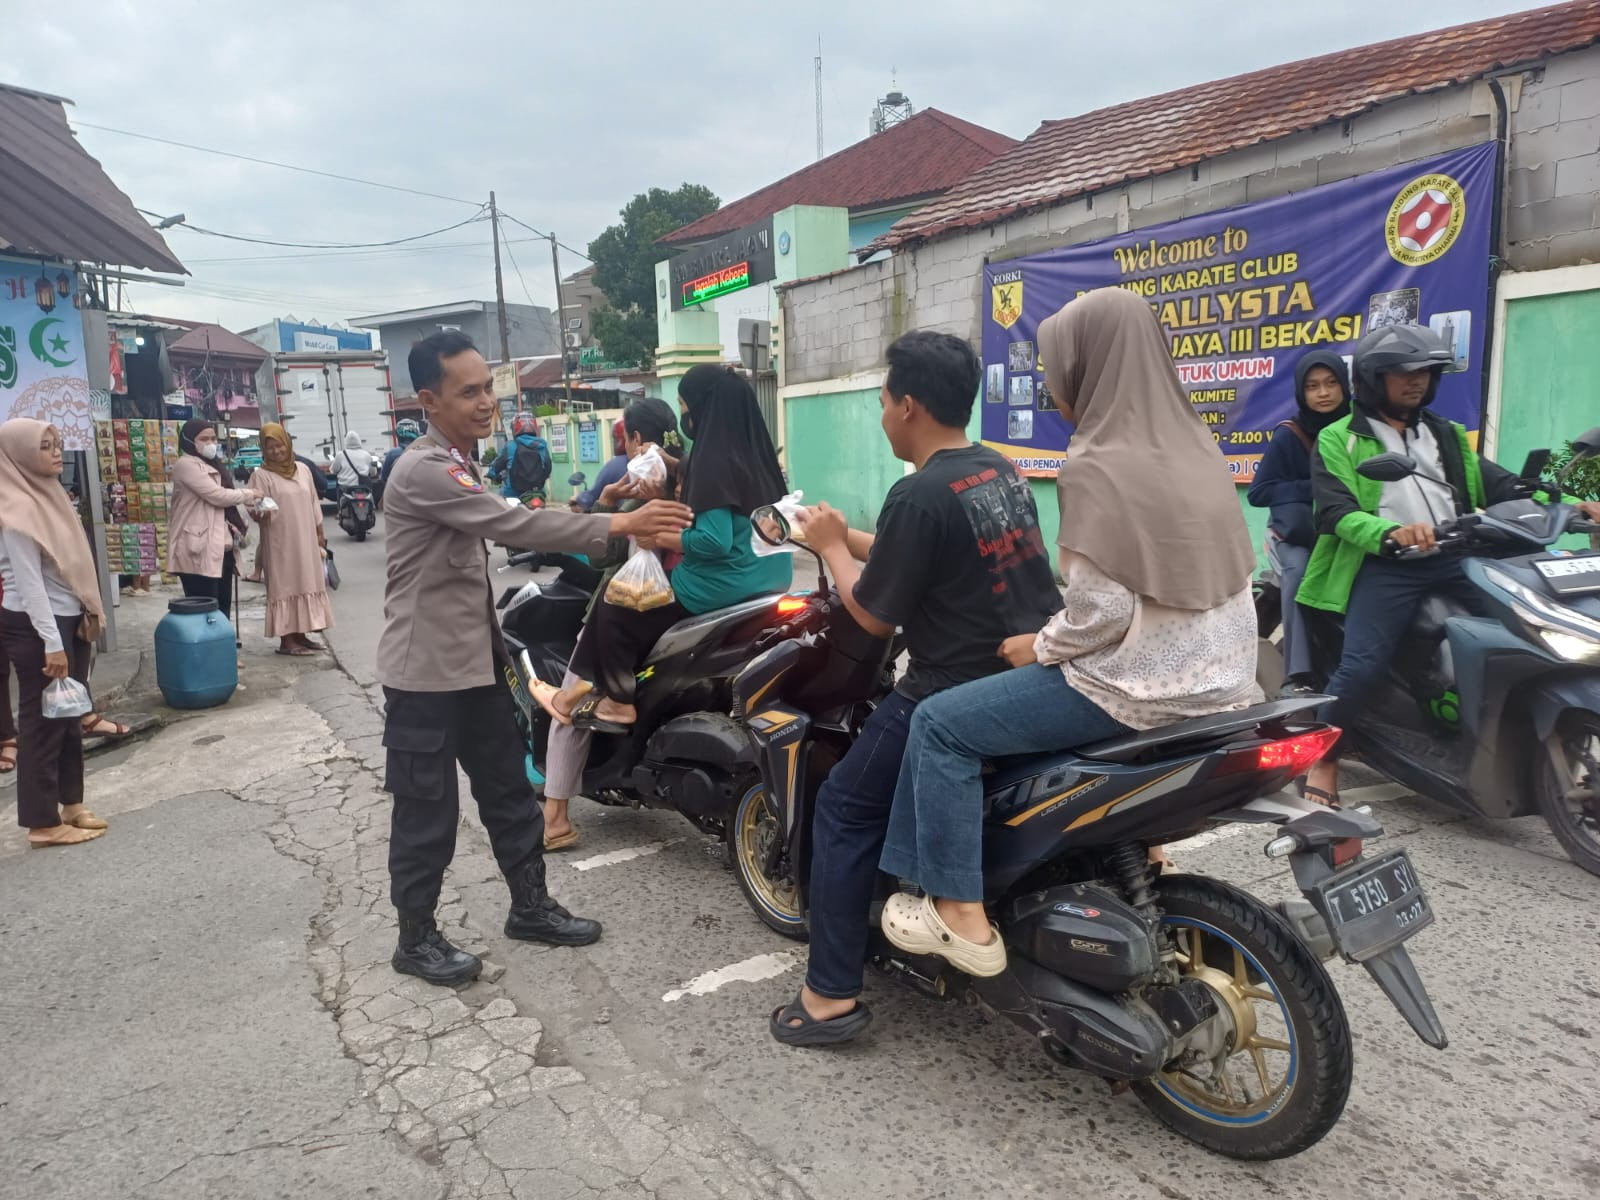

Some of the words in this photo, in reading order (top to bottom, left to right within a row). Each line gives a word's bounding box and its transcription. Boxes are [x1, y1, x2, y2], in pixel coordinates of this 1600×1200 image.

[1420, 178, 1452, 190] KARATE
[1113, 234, 1216, 274] Welcome
[1222, 226, 1248, 253] to
[1433, 225, 1459, 255] DHARMA
[993, 269, 1021, 285] FORKI
[1160, 263, 1236, 294] KARATE
[1240, 252, 1298, 280] CLUB
[1171, 330, 1225, 358] JAYA
[1230, 325, 1252, 352] III
[1260, 315, 1363, 348] BEKASI
[1217, 357, 1275, 383] UMUM
[1190, 389, 1236, 404] KUMITE
[1229, 431, 1263, 444] 21.00
[769, 724, 799, 743] HONDA
[1350, 877, 1389, 916] 5750
